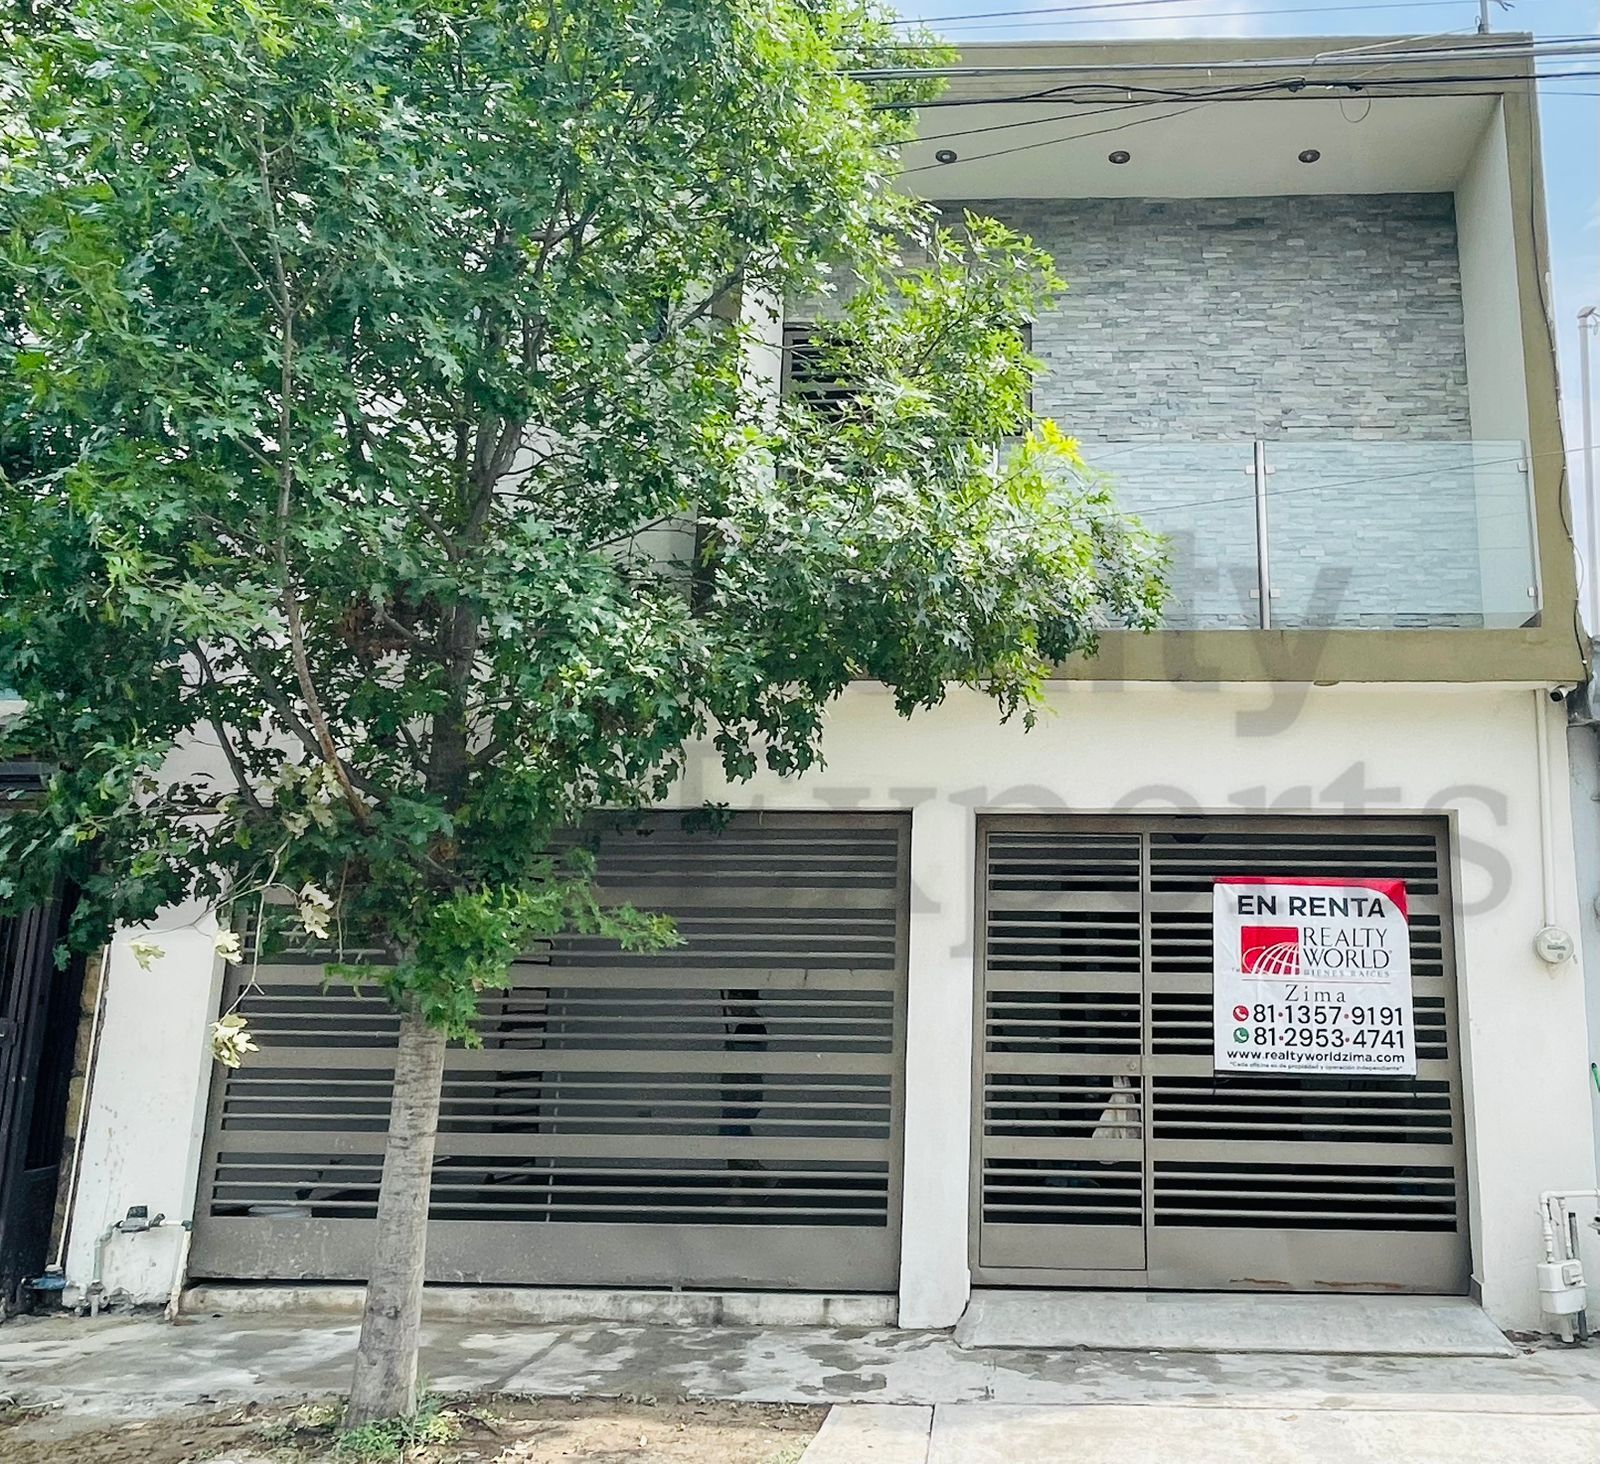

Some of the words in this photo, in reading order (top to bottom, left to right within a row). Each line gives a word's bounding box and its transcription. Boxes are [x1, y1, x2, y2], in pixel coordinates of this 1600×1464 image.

[1237, 895, 1276, 916] EN
[1289, 896, 1386, 918] RENTA
[1303, 927, 1388, 948] REALTY
[1303, 948, 1390, 969] WORLD
[1285, 984, 1346, 1003] Zima
[1227, 1050, 1405, 1063] www.realtyworldzima.com
